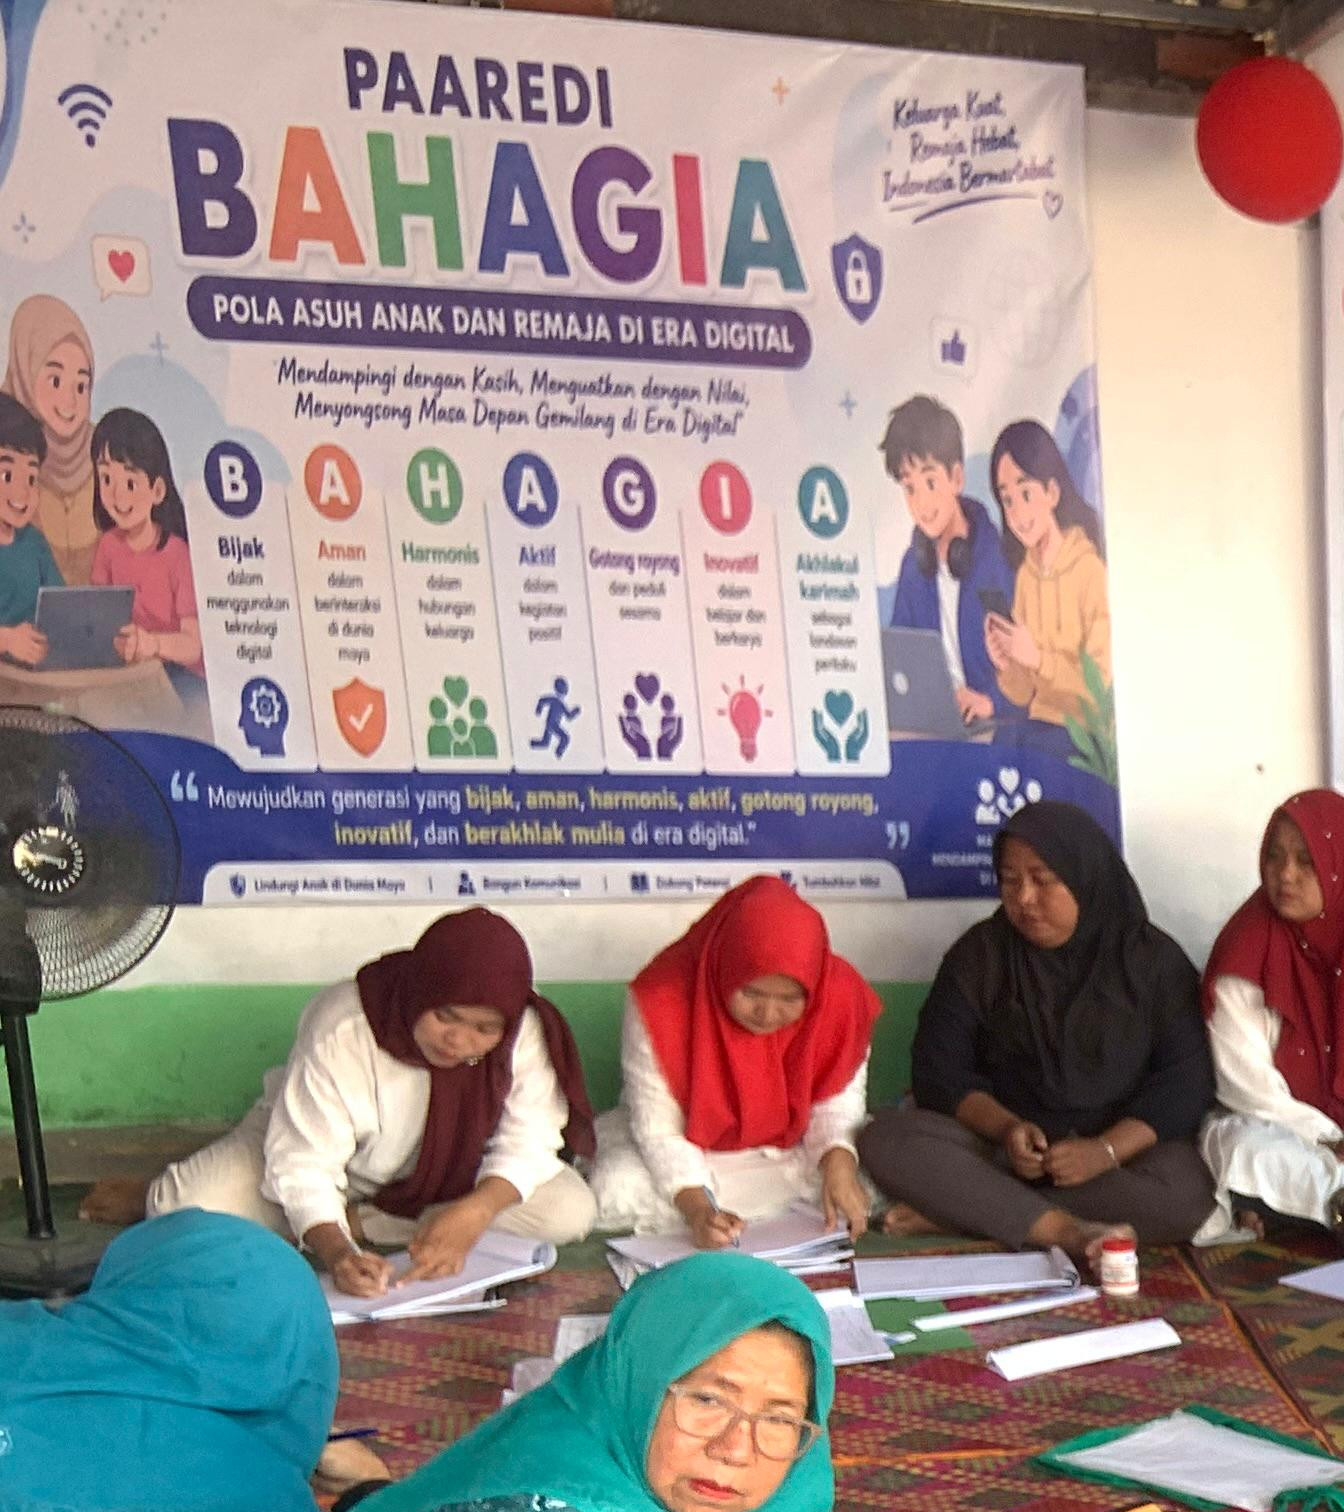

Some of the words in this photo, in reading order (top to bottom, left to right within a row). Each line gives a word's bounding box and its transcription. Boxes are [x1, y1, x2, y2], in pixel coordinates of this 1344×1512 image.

[343, 46, 612, 129] PAAREDI
[167, 117, 807, 294] BAHAGIA
[212, 294, 284, 326] POLA
[292, 298, 363, 330] ASUH
[372, 301, 445, 335] ANAK
[452, 306, 507, 338] DAN
[513, 308, 612, 343] REMAJA
[618, 314, 644, 346] DI
[651, 315, 698, 350] ERA
[704, 318, 795, 354] DIGITAL
[403, 364, 466, 397] dengan
[472, 366, 523, 396] Kasih,
[530, 369, 636, 405] Menguatkan
[641, 376, 702, 410] dengan
[294, 392, 411, 430] Menyongsong
[418, 397, 467, 426] Masa
[472, 399, 529, 433] Depan
[536, 401, 615, 439] Gemilang
[622, 405, 638, 433] di
[644, 406, 677, 436] Era
[219, 455, 249, 502] B
[319, 459, 351, 506] A
[419, 462, 450, 509] H
[517, 464, 548, 512] A
[614, 469, 646, 517] G
[719, 475, 733, 520] I
[810, 478, 840, 524] A
[218, 536, 265, 563] Bijak
[318, 540, 366, 562] Aman
[402, 542, 480, 565] Harmonis
[519, 544, 556, 566] Aktif
[589, 546, 635, 575] Gotong
[208, 784, 326, 814] Mewujudkan
[332, 786, 410, 815] generasi
[416, 788, 461, 815] yang
[466, 785, 521, 814] bijak,
[525, 788, 585, 812] aman,
[587, 786, 684, 814] harmonis,
[741, 788, 806, 816] gotong
[334, 819, 419, 849] inovatif,
[423, 822, 459, 846] dan
[465, 819, 565, 846] berakhlak
[571, 821, 625, 846] mulia
[631, 821, 649, 846] di
[654, 825, 683, 846] era
